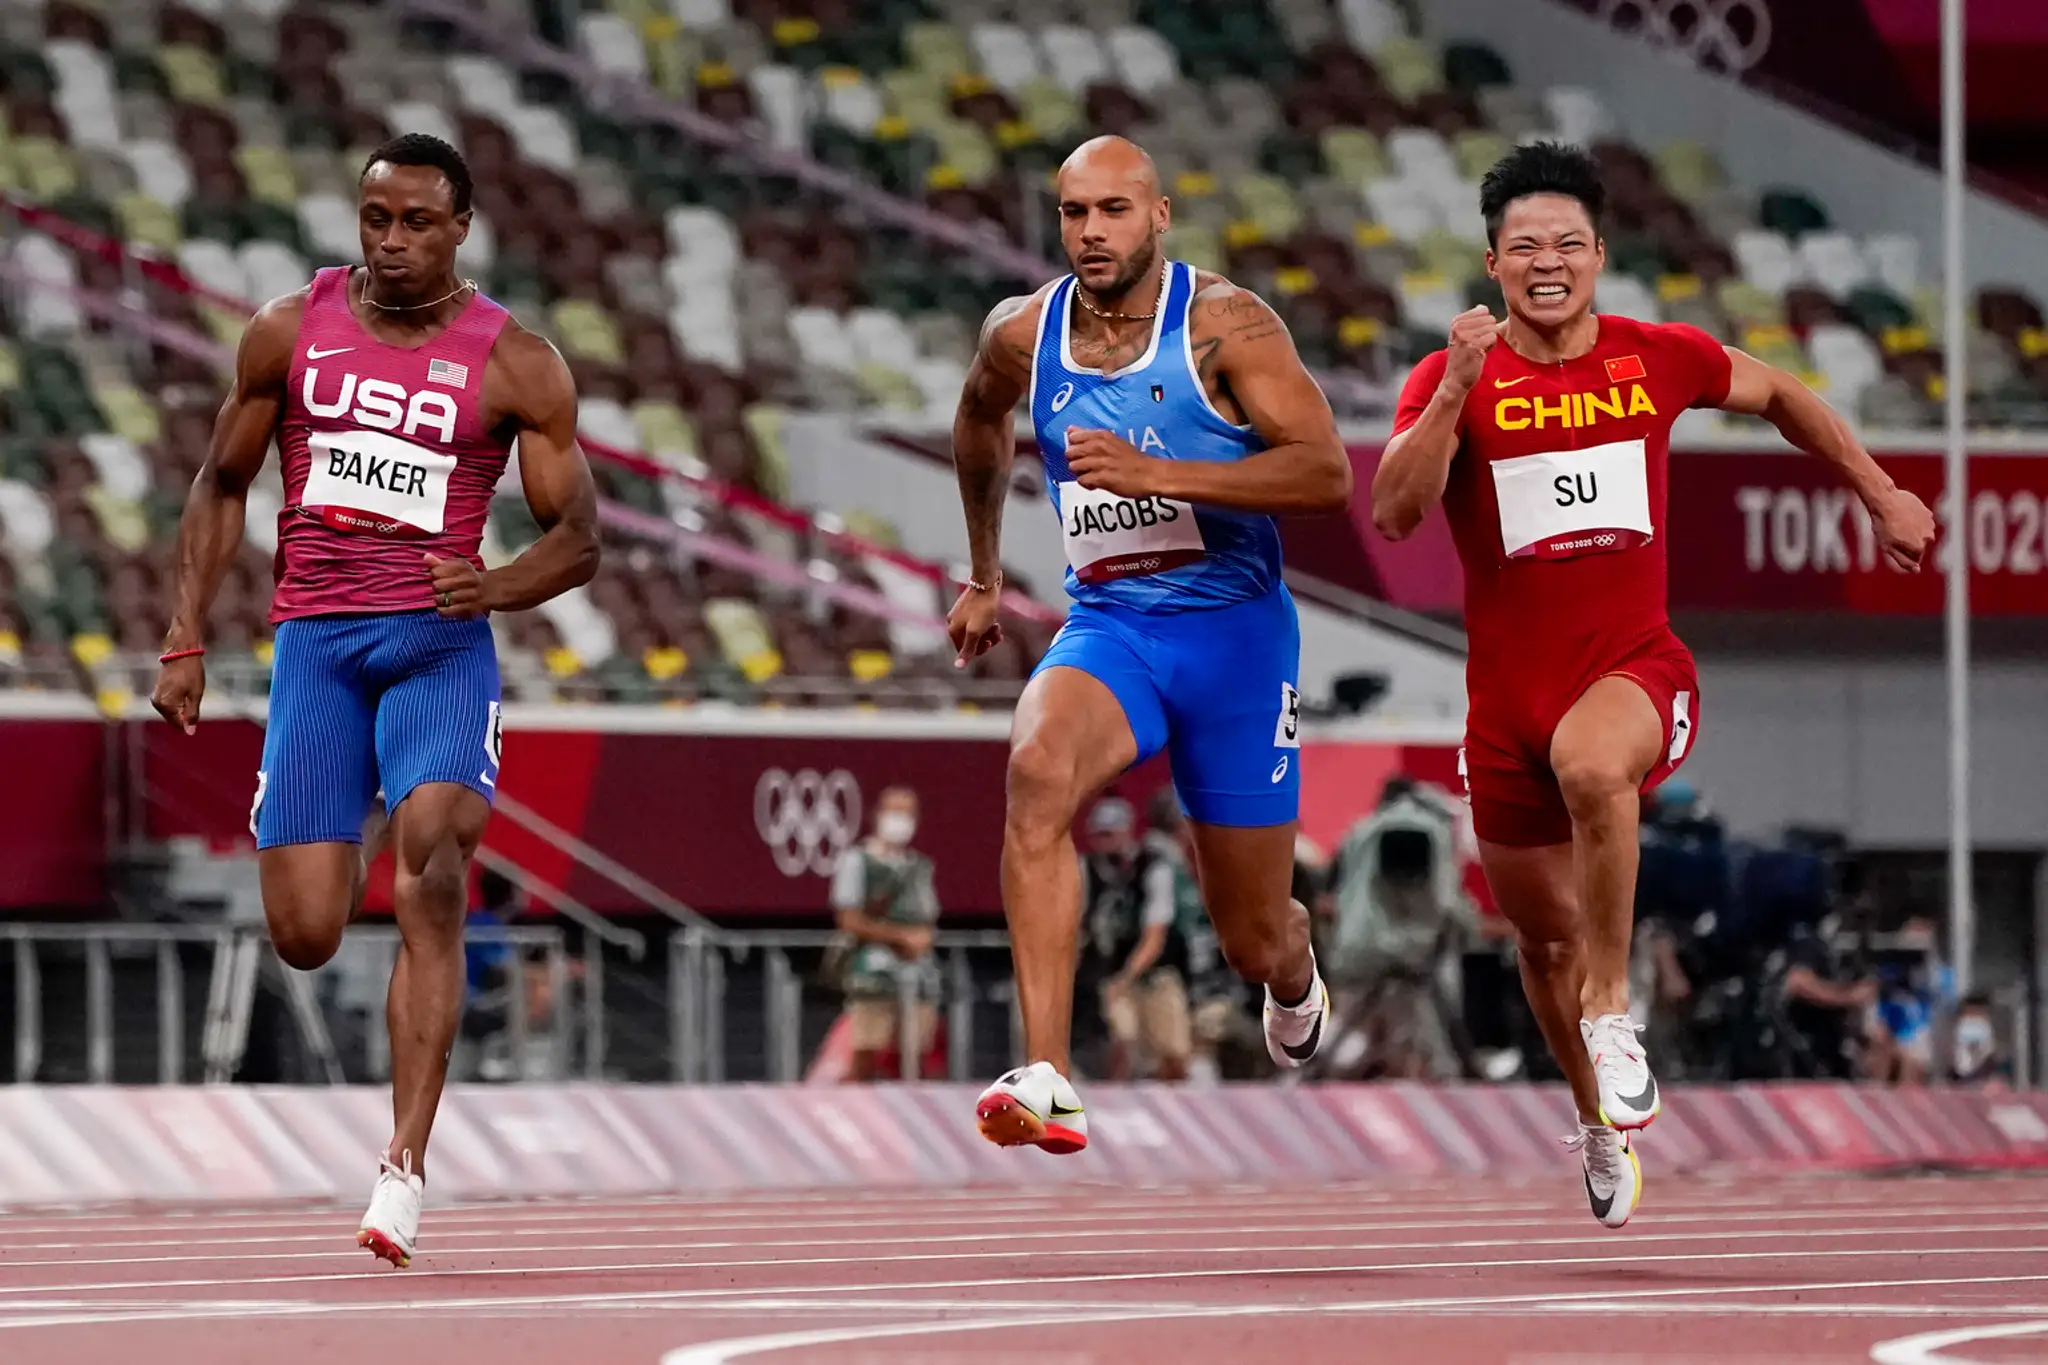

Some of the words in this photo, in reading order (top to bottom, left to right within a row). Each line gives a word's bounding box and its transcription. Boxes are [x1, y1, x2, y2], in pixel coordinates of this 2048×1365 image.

[302, 367, 458, 443] USA
[1495, 384, 1657, 431] CHINA
[328, 447, 427, 498] BAKER
[1553, 471, 1598, 507] SU
[335, 513, 357, 525] TOKYO
[357, 519, 374, 528] 2020
[1069, 496, 1179, 537] JACOBS
[1735, 486, 1920, 574] TOKY
[1550, 541, 1574, 551] TOKYO
[1574, 538, 1593, 548] 2020
